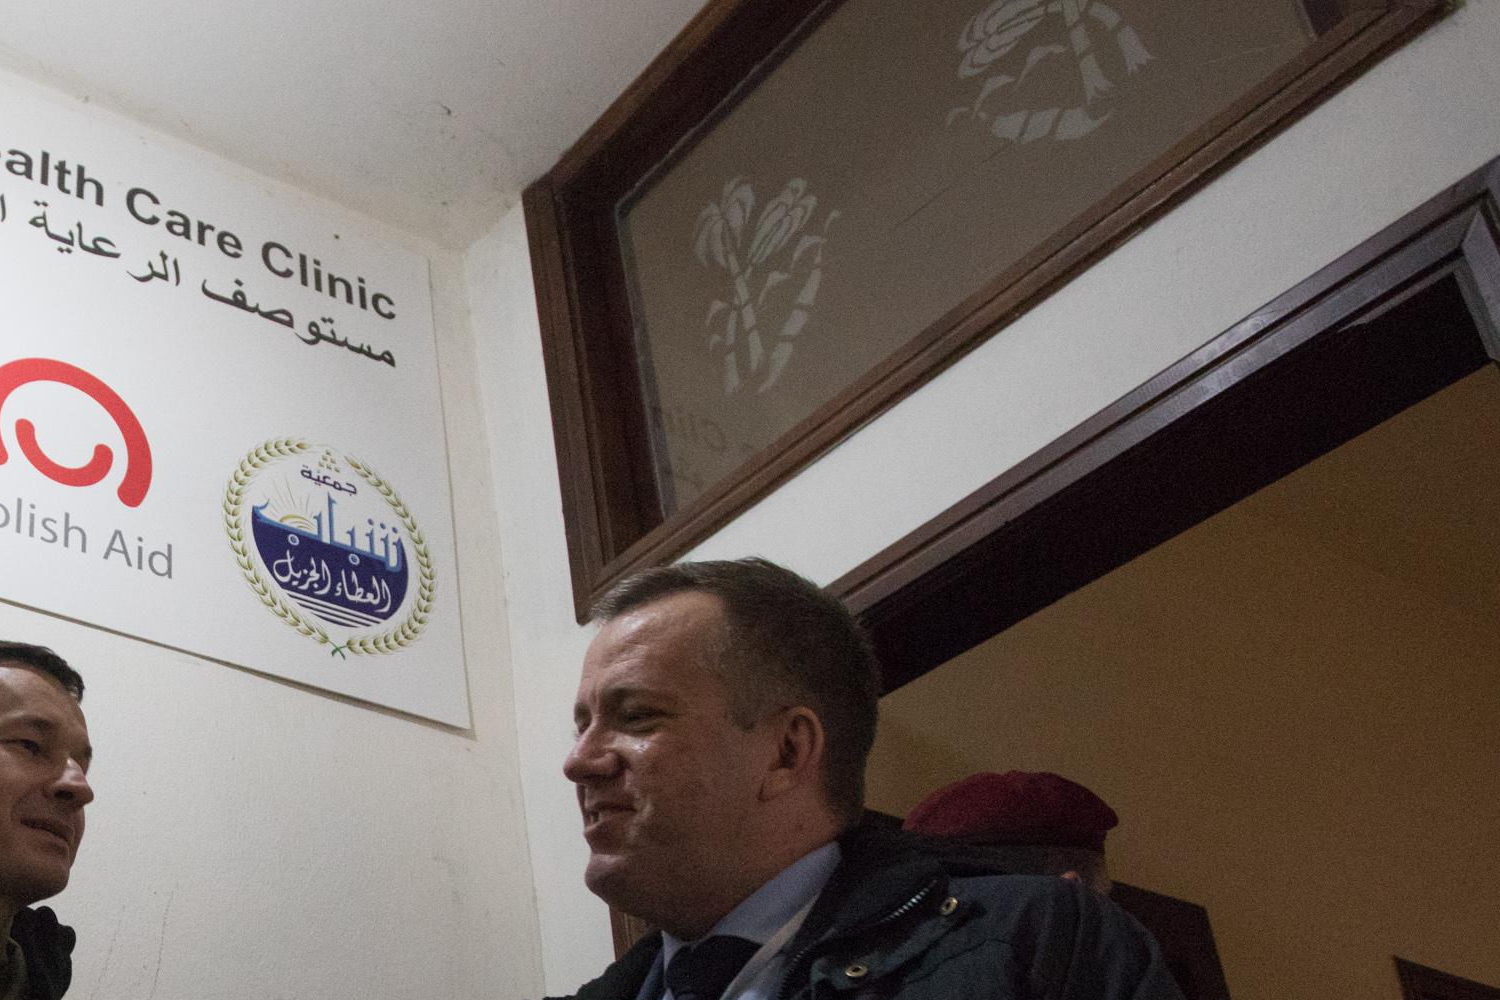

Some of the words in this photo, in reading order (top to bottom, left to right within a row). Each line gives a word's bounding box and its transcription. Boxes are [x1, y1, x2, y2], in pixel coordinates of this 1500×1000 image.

[28, 199, 181, 287] الرعاية
[126, 187, 243, 259] Care
[261, 240, 396, 320] Clinic
[201, 278, 396, 368] مستوصف
[300, 464, 357, 497] جمعية
[103, 529, 174, 580] Aid
[252, 491, 403, 573] شباب
[273, 549, 331, 596] الجزيل
[335, 568, 392, 613] العطاء
